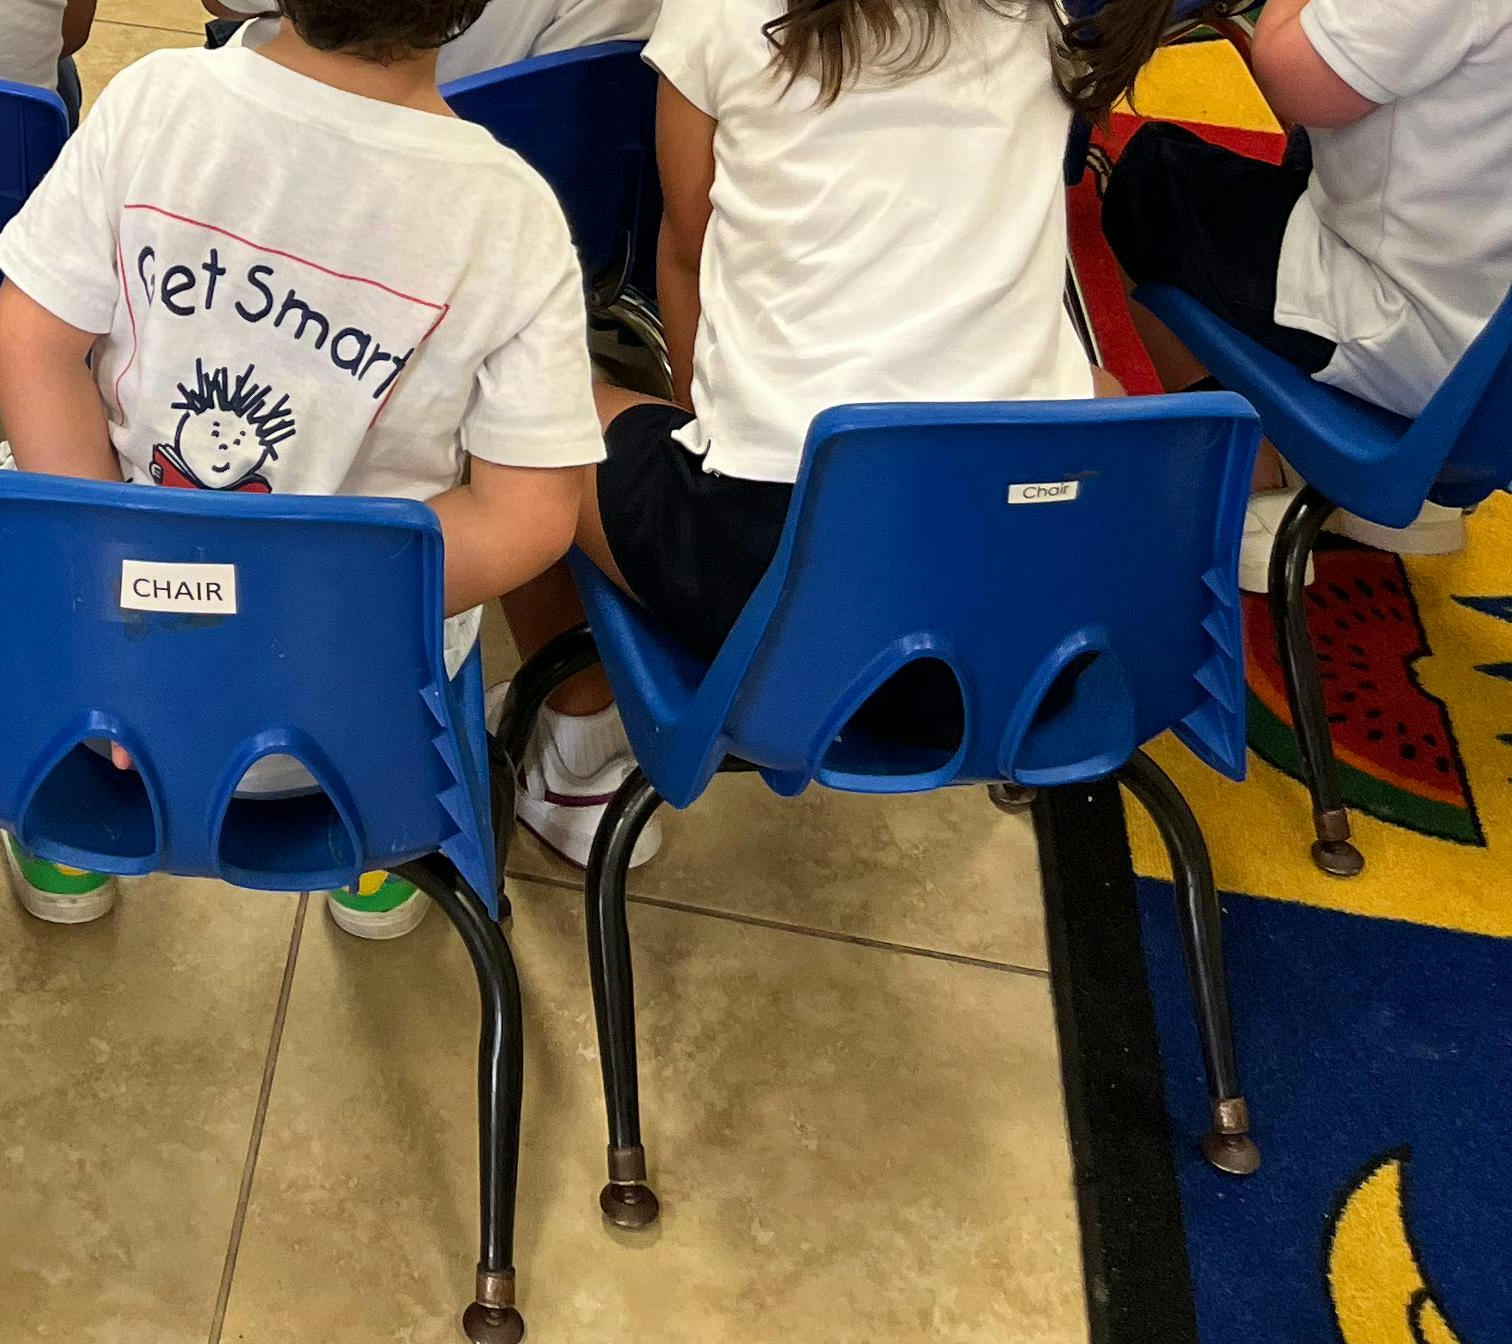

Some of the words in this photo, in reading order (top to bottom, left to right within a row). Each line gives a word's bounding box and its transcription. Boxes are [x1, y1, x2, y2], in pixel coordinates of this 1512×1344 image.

[234, 264, 414, 399] Smart
[1022, 482, 1070, 499] Chair
[133, 578, 223, 601] CHAIR
